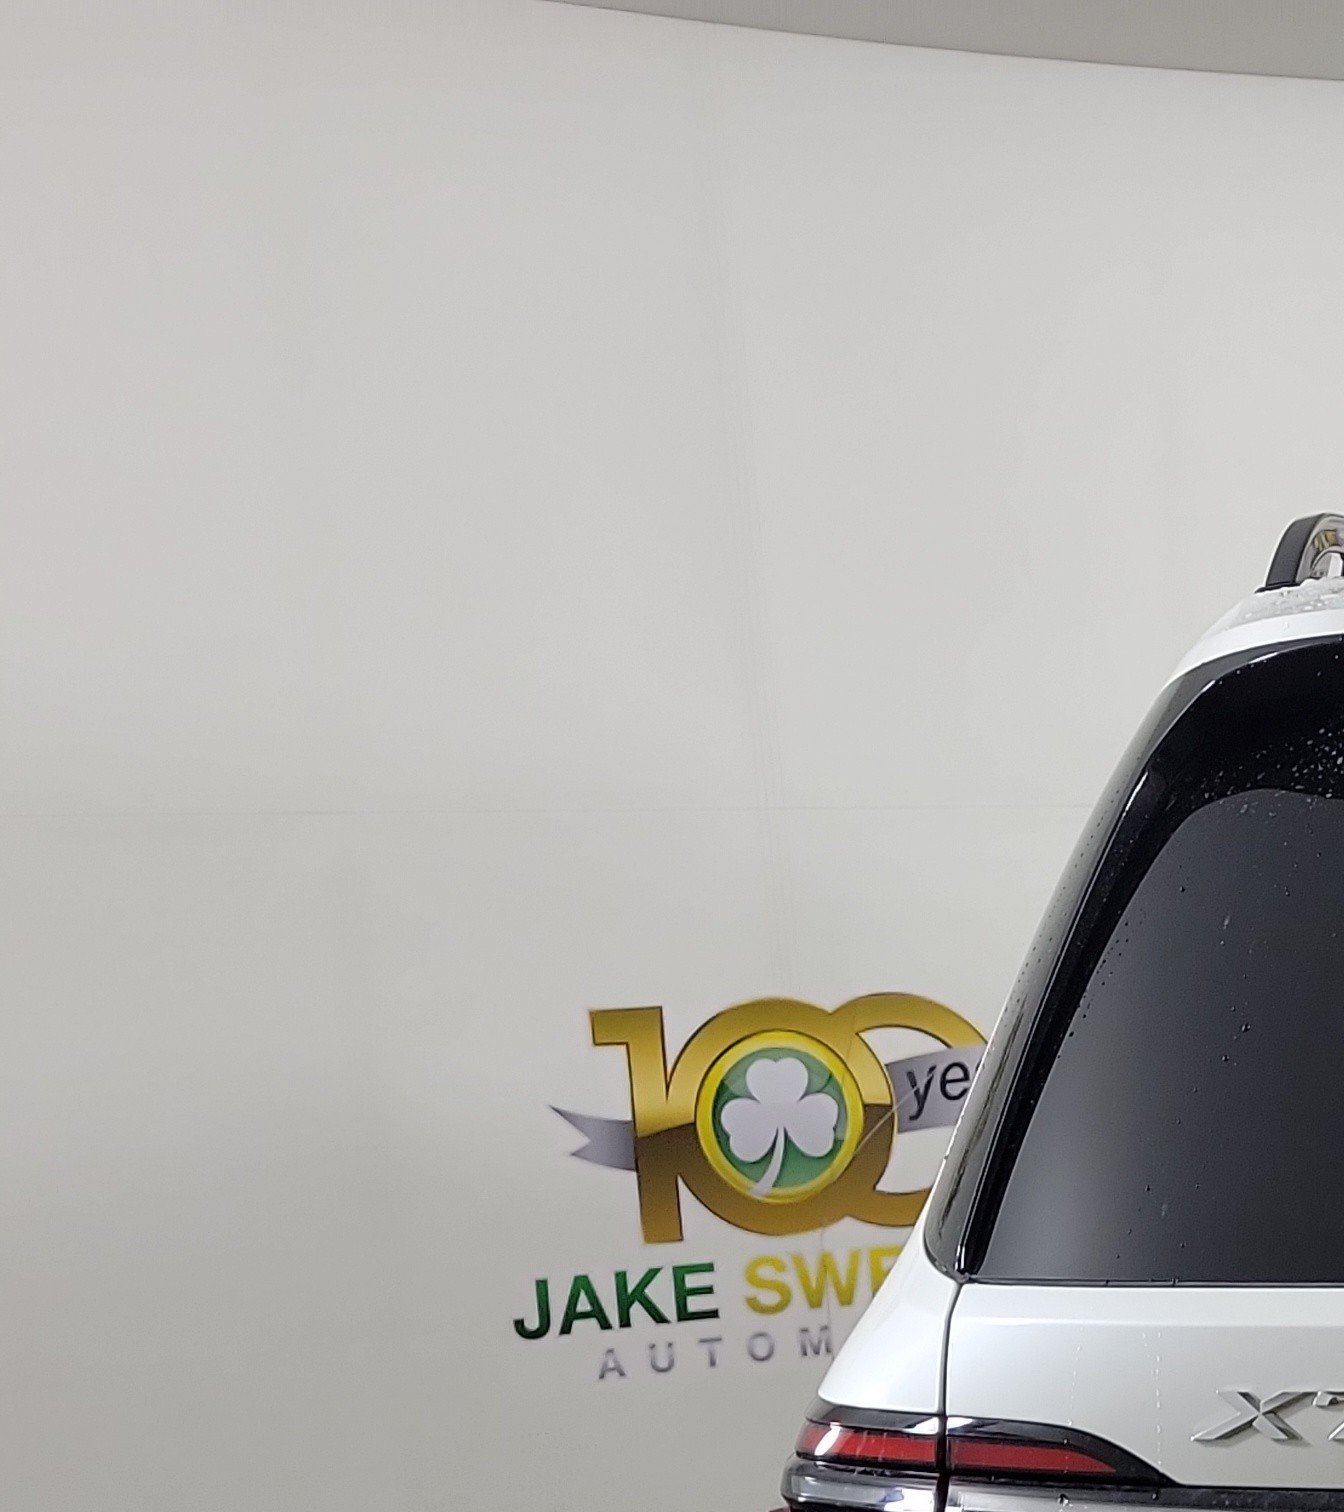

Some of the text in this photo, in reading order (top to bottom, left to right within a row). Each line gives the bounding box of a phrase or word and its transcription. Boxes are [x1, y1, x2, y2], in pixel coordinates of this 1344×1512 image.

[906, 1057, 984, 1121] ye
[512, 1261, 720, 1340] JAKE
[597, 1325, 832, 1381] AUTOM
